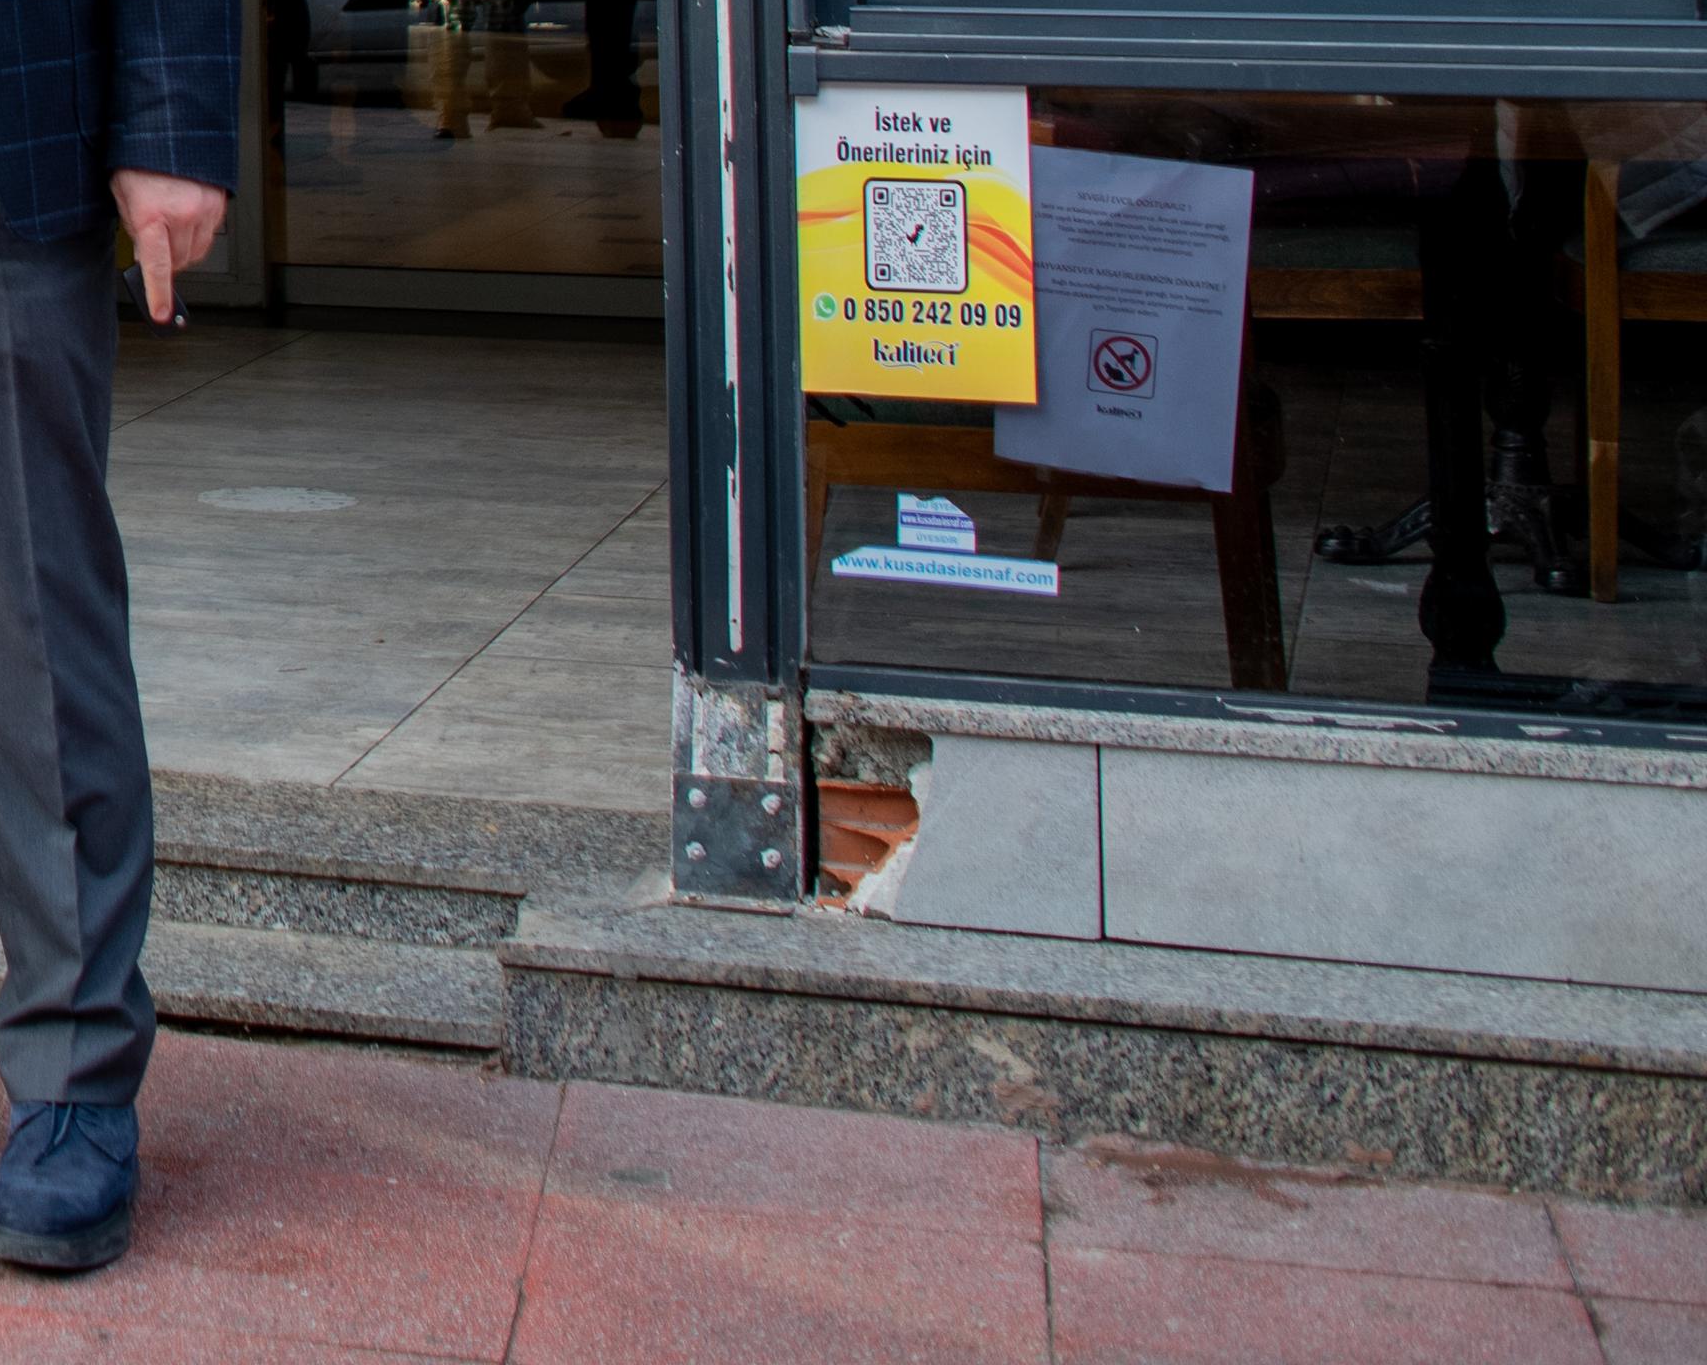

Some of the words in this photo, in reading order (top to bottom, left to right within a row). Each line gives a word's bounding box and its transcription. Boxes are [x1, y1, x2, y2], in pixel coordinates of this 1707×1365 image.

[875, 106, 922, 132] İstek
[929, 116, 951, 133] ve
[836, 137, 949, 165] Önerileriniz
[955, 144, 992, 171] için
[843, 297, 857, 321] 0
[864, 298, 904, 323] 850
[911, 300, 952, 325] 242
[960, 302, 987, 327] 09
[995, 304, 1021, 328] 09
[871, 337, 957, 372] kaliteci
[837, 554, 1054, 586] www.kusadasiesnaf.com
